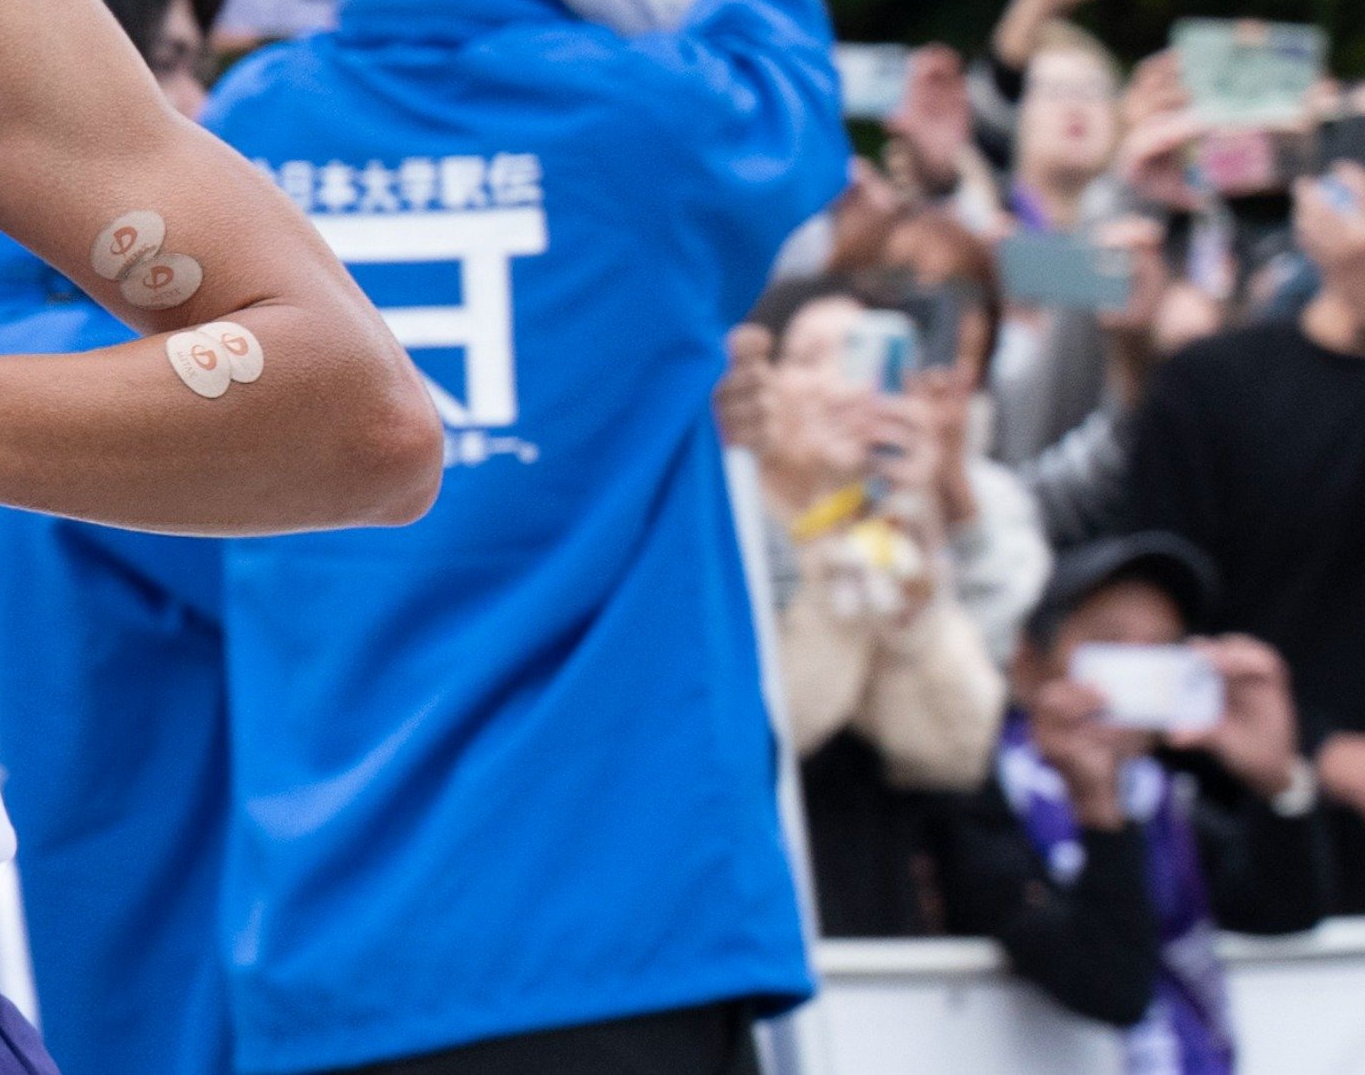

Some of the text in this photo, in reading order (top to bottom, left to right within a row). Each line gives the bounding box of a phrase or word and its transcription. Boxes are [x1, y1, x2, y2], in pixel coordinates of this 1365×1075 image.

[253, 152, 543, 214] 日本大学駅伝
